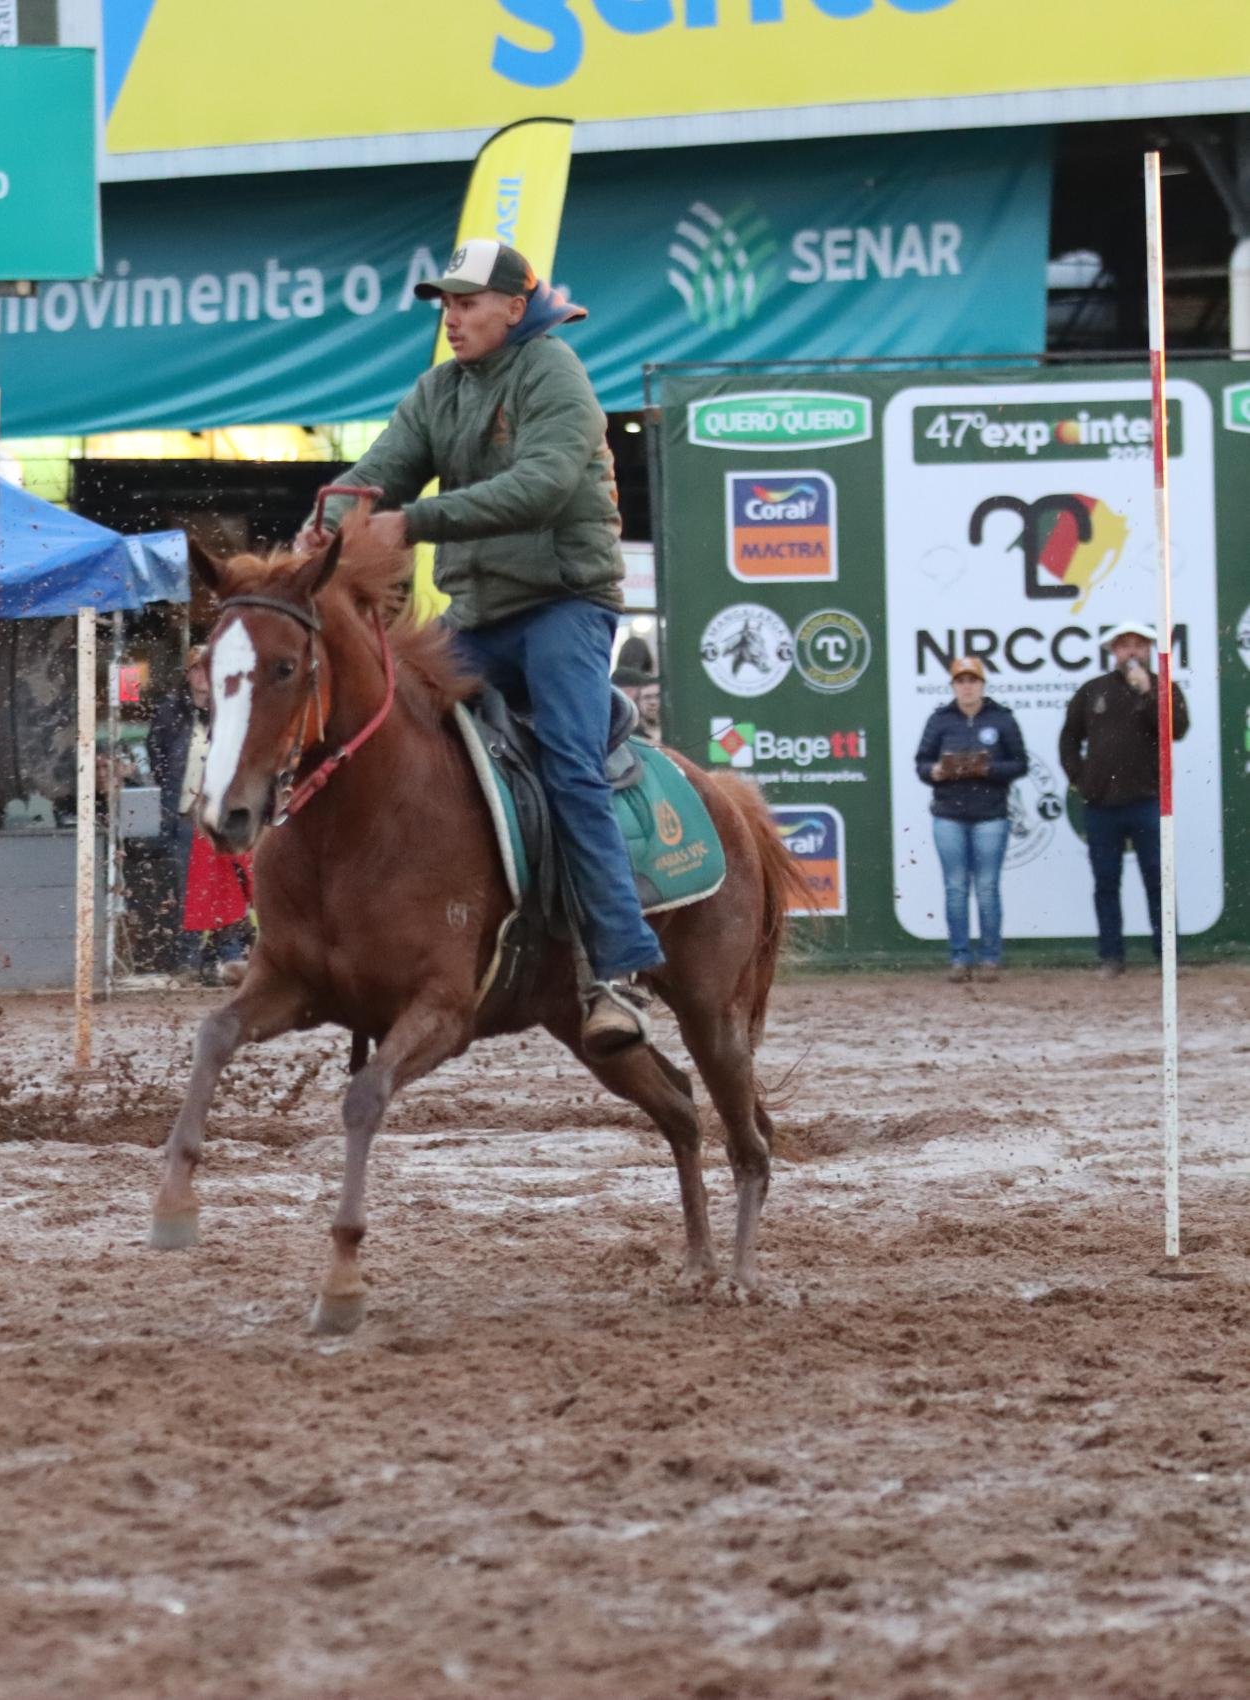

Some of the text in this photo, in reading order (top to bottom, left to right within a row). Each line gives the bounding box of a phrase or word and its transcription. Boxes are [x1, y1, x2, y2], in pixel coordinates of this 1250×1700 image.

[493, 176, 524, 247] ASIL
[787, 221, 963, 285] SENAR
[343, 262, 382, 316] o
[704, 408, 857, 437] QUERO QUERO
[744, 498, 808, 521] Coral
[740, 541, 827, 560] MACTRA
[754, 728, 867, 767] Bagetti
[783, 835, 815, 854] ral
